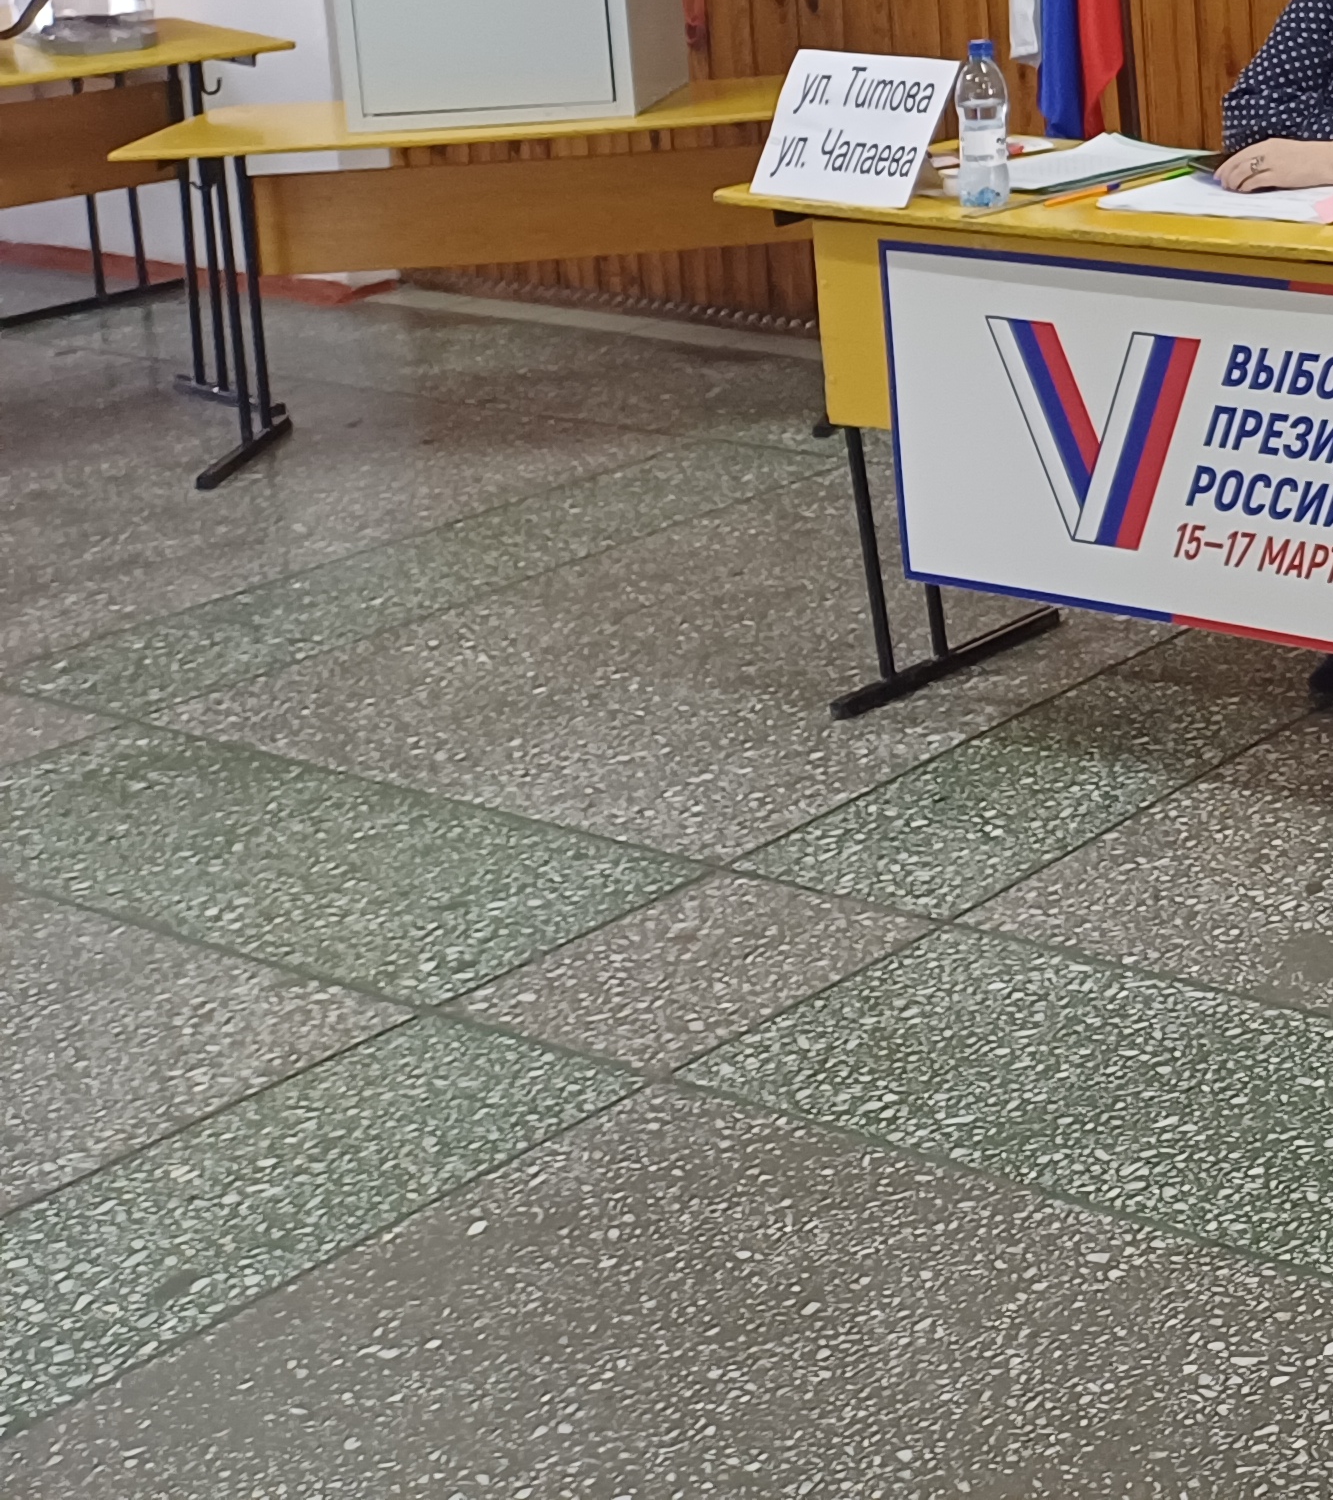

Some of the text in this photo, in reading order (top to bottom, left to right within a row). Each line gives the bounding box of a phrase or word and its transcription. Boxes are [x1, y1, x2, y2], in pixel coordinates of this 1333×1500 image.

[793, 66, 936, 115] ул. Титова
[770, 128, 919, 179] ул. Чапаева
